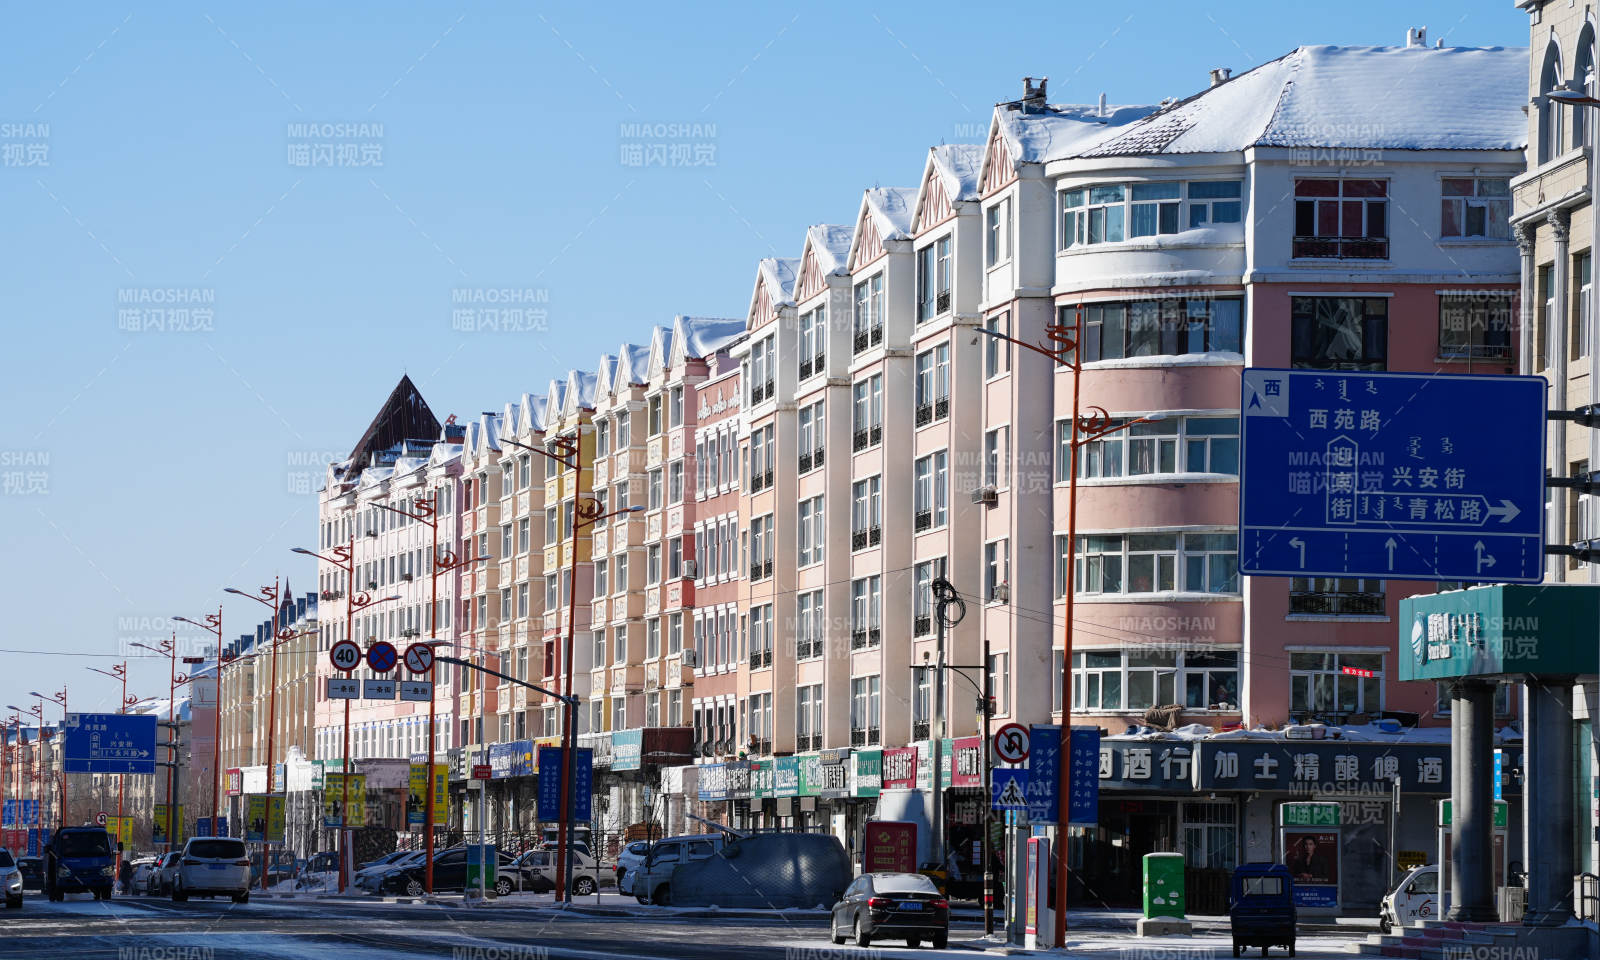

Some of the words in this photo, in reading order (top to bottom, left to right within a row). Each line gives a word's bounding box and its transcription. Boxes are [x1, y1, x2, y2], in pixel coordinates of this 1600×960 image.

[1264, 379, 1282, 397] 西
[1309, 409, 1381, 431] 西苑路
[1392, 466, 1465, 489] 兴安街
[1408, 498, 1481, 521] 青松路
[336, 649, 354, 663] 40
[1215, 751, 1443, 785] 加士精酿啤酒
